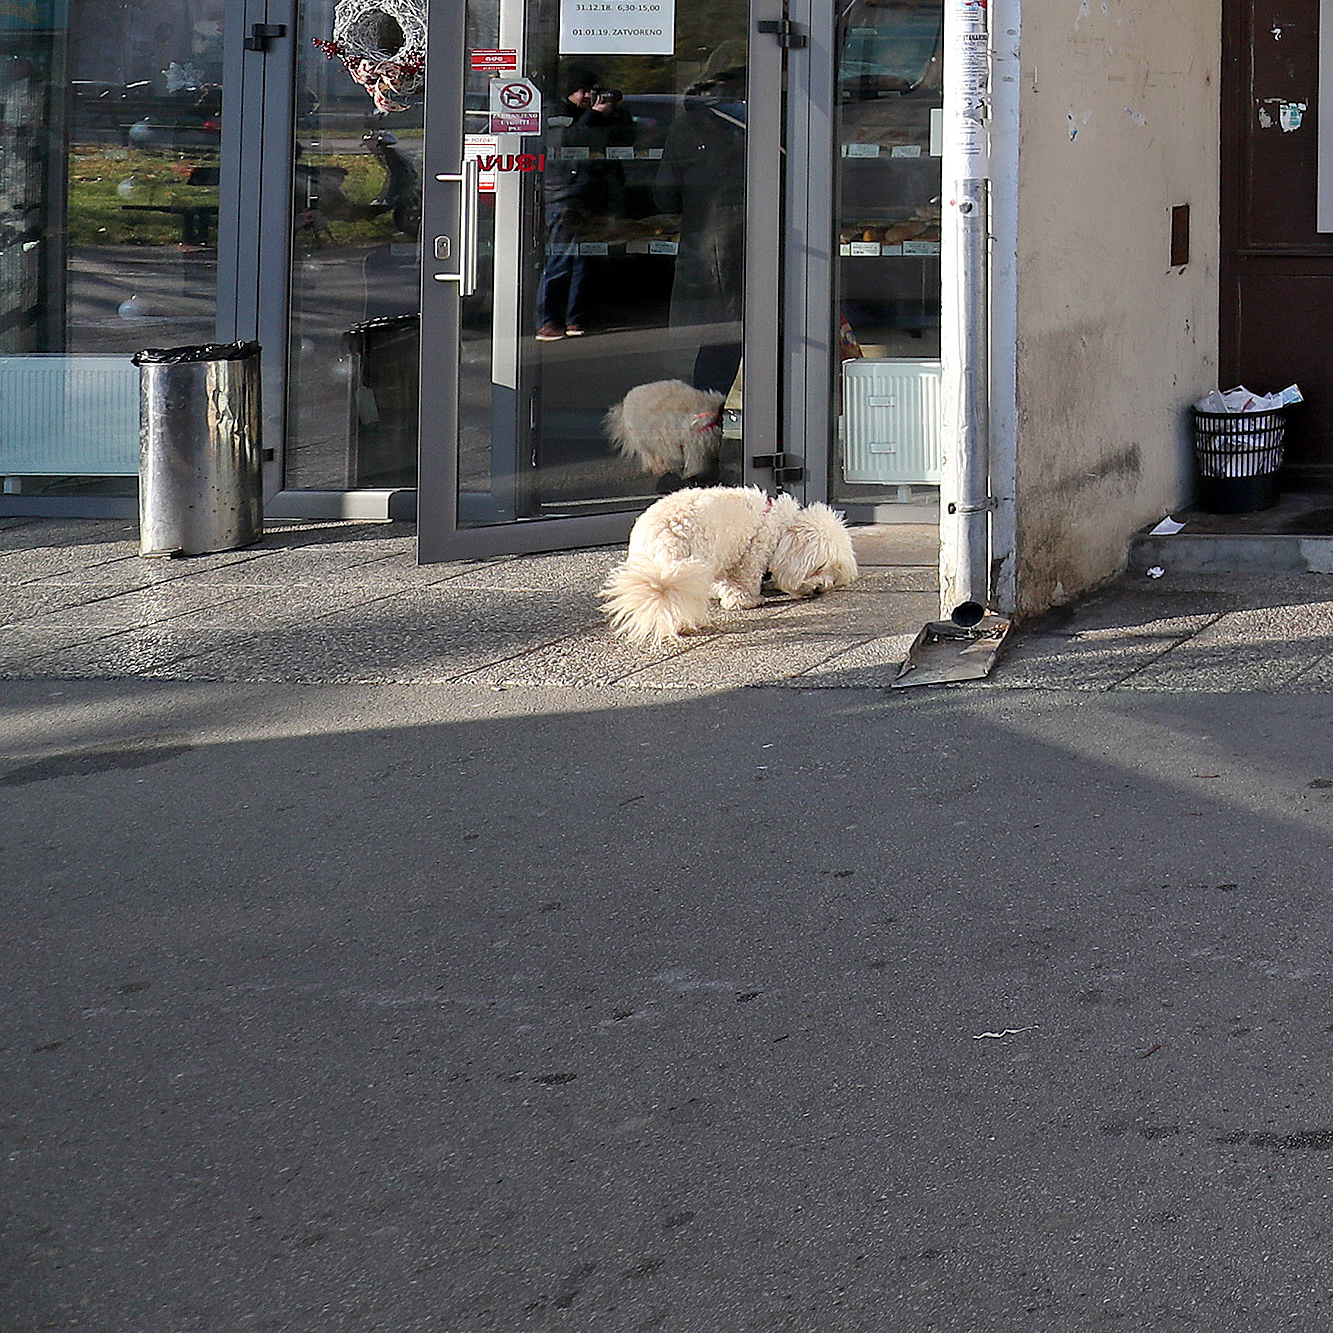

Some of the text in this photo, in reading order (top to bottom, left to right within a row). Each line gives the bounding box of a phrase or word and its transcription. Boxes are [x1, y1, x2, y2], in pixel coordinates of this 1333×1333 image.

[576, 4, 660, 12] 31.12.18. 6,30-15,00
[572, 28, 663, 36] 01.01.19. ZATVORENO
